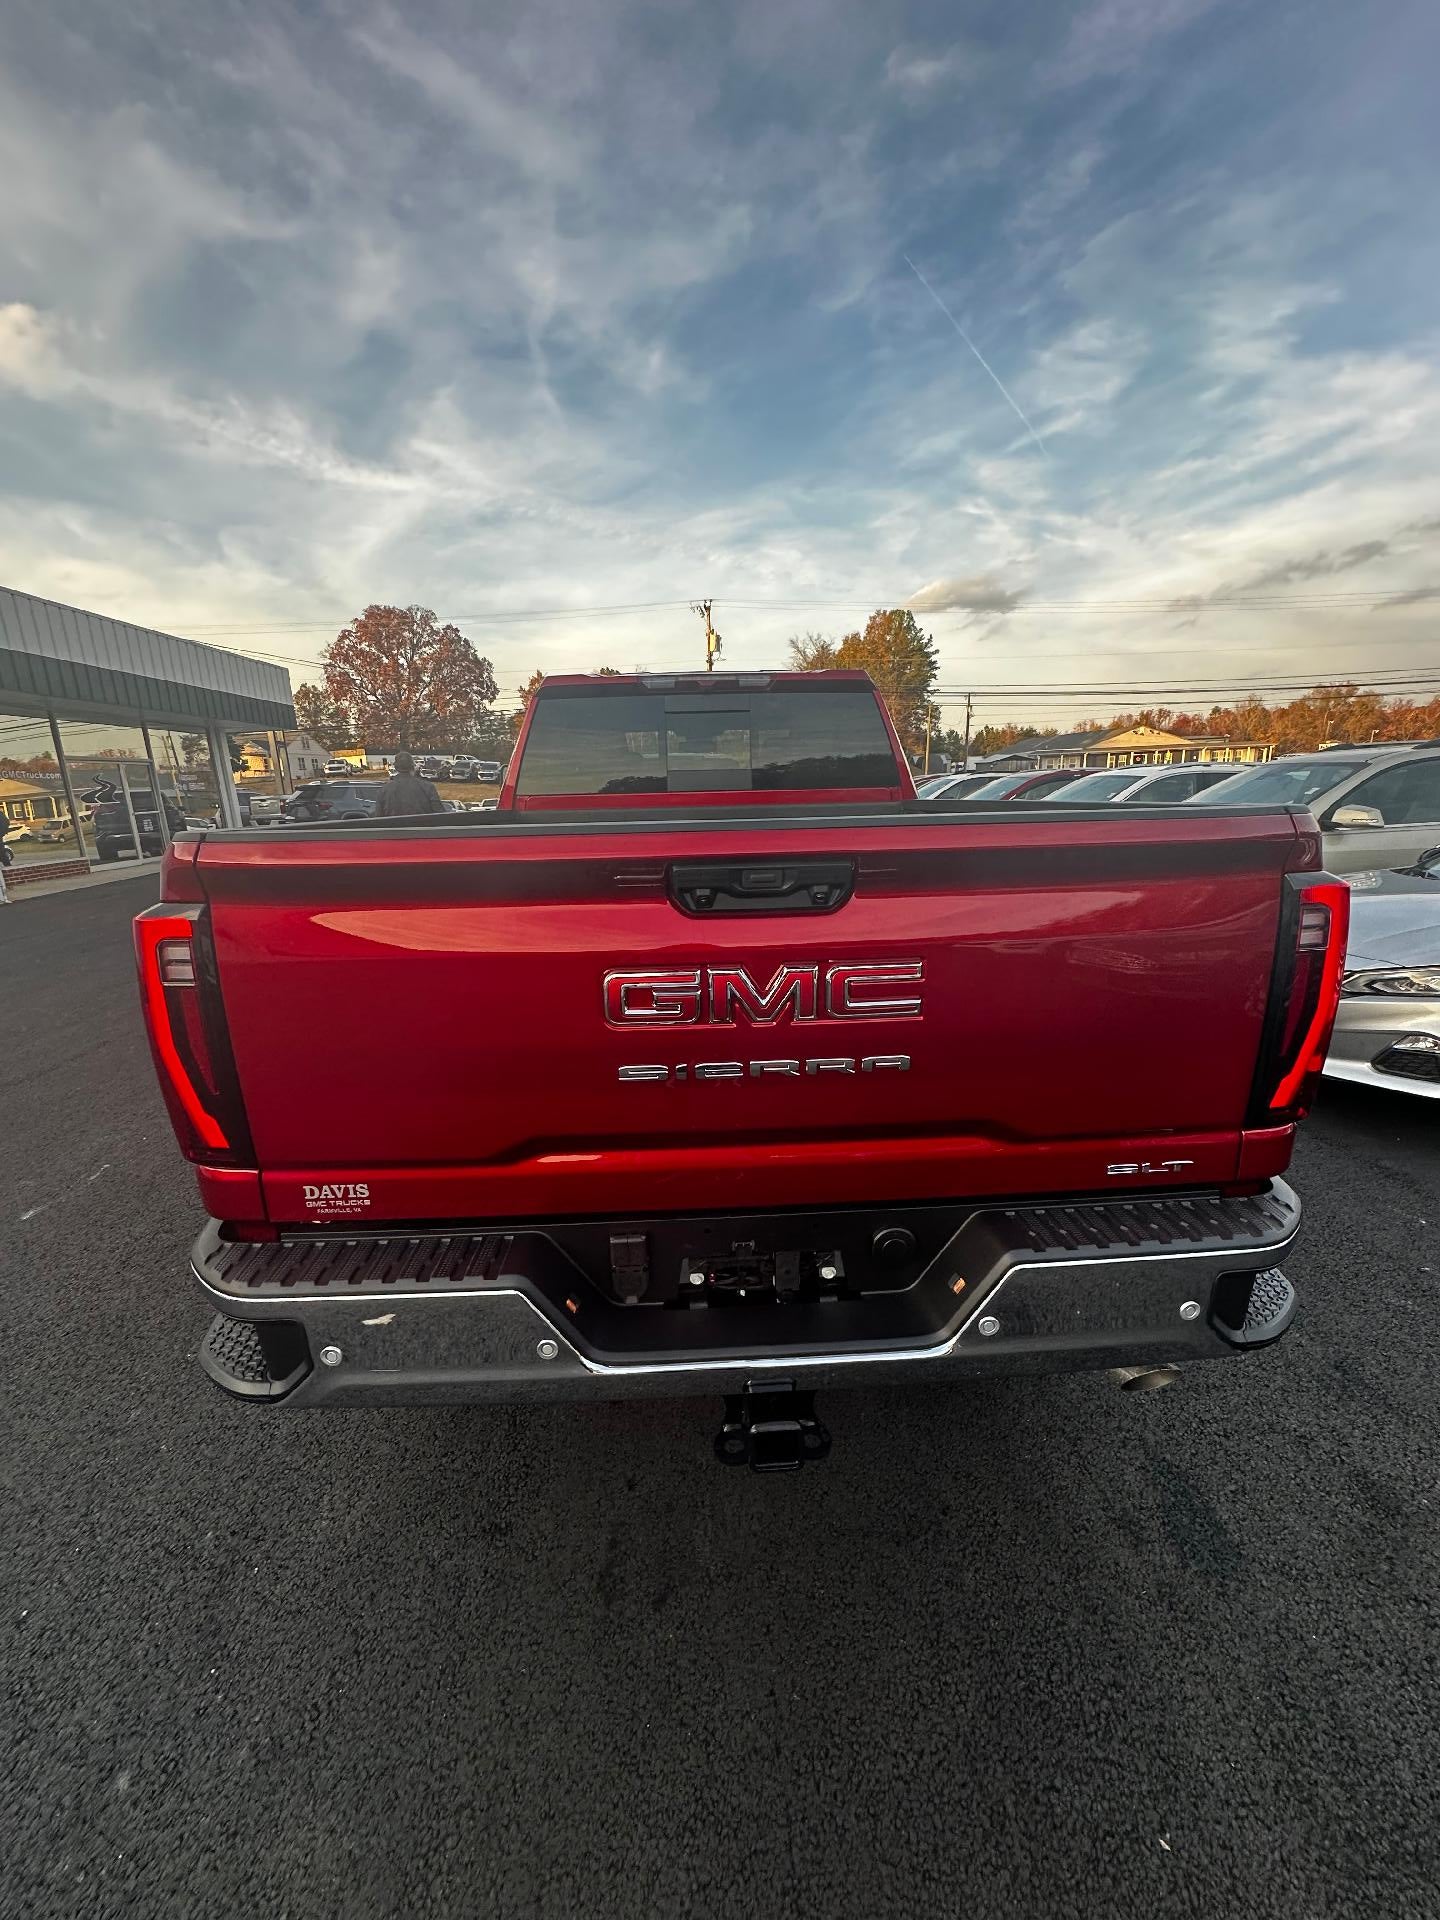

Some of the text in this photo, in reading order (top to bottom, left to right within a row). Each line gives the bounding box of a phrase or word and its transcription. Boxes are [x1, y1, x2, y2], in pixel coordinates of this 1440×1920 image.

[0, 770, 61, 779] GMCTruck.com
[603, 959, 924, 1027] GMC
[618, 1055, 911, 1081] SIERRA
[1107, 1160, 1194, 1174] SLT
[303, 1184, 369, 1199] DAVIS
